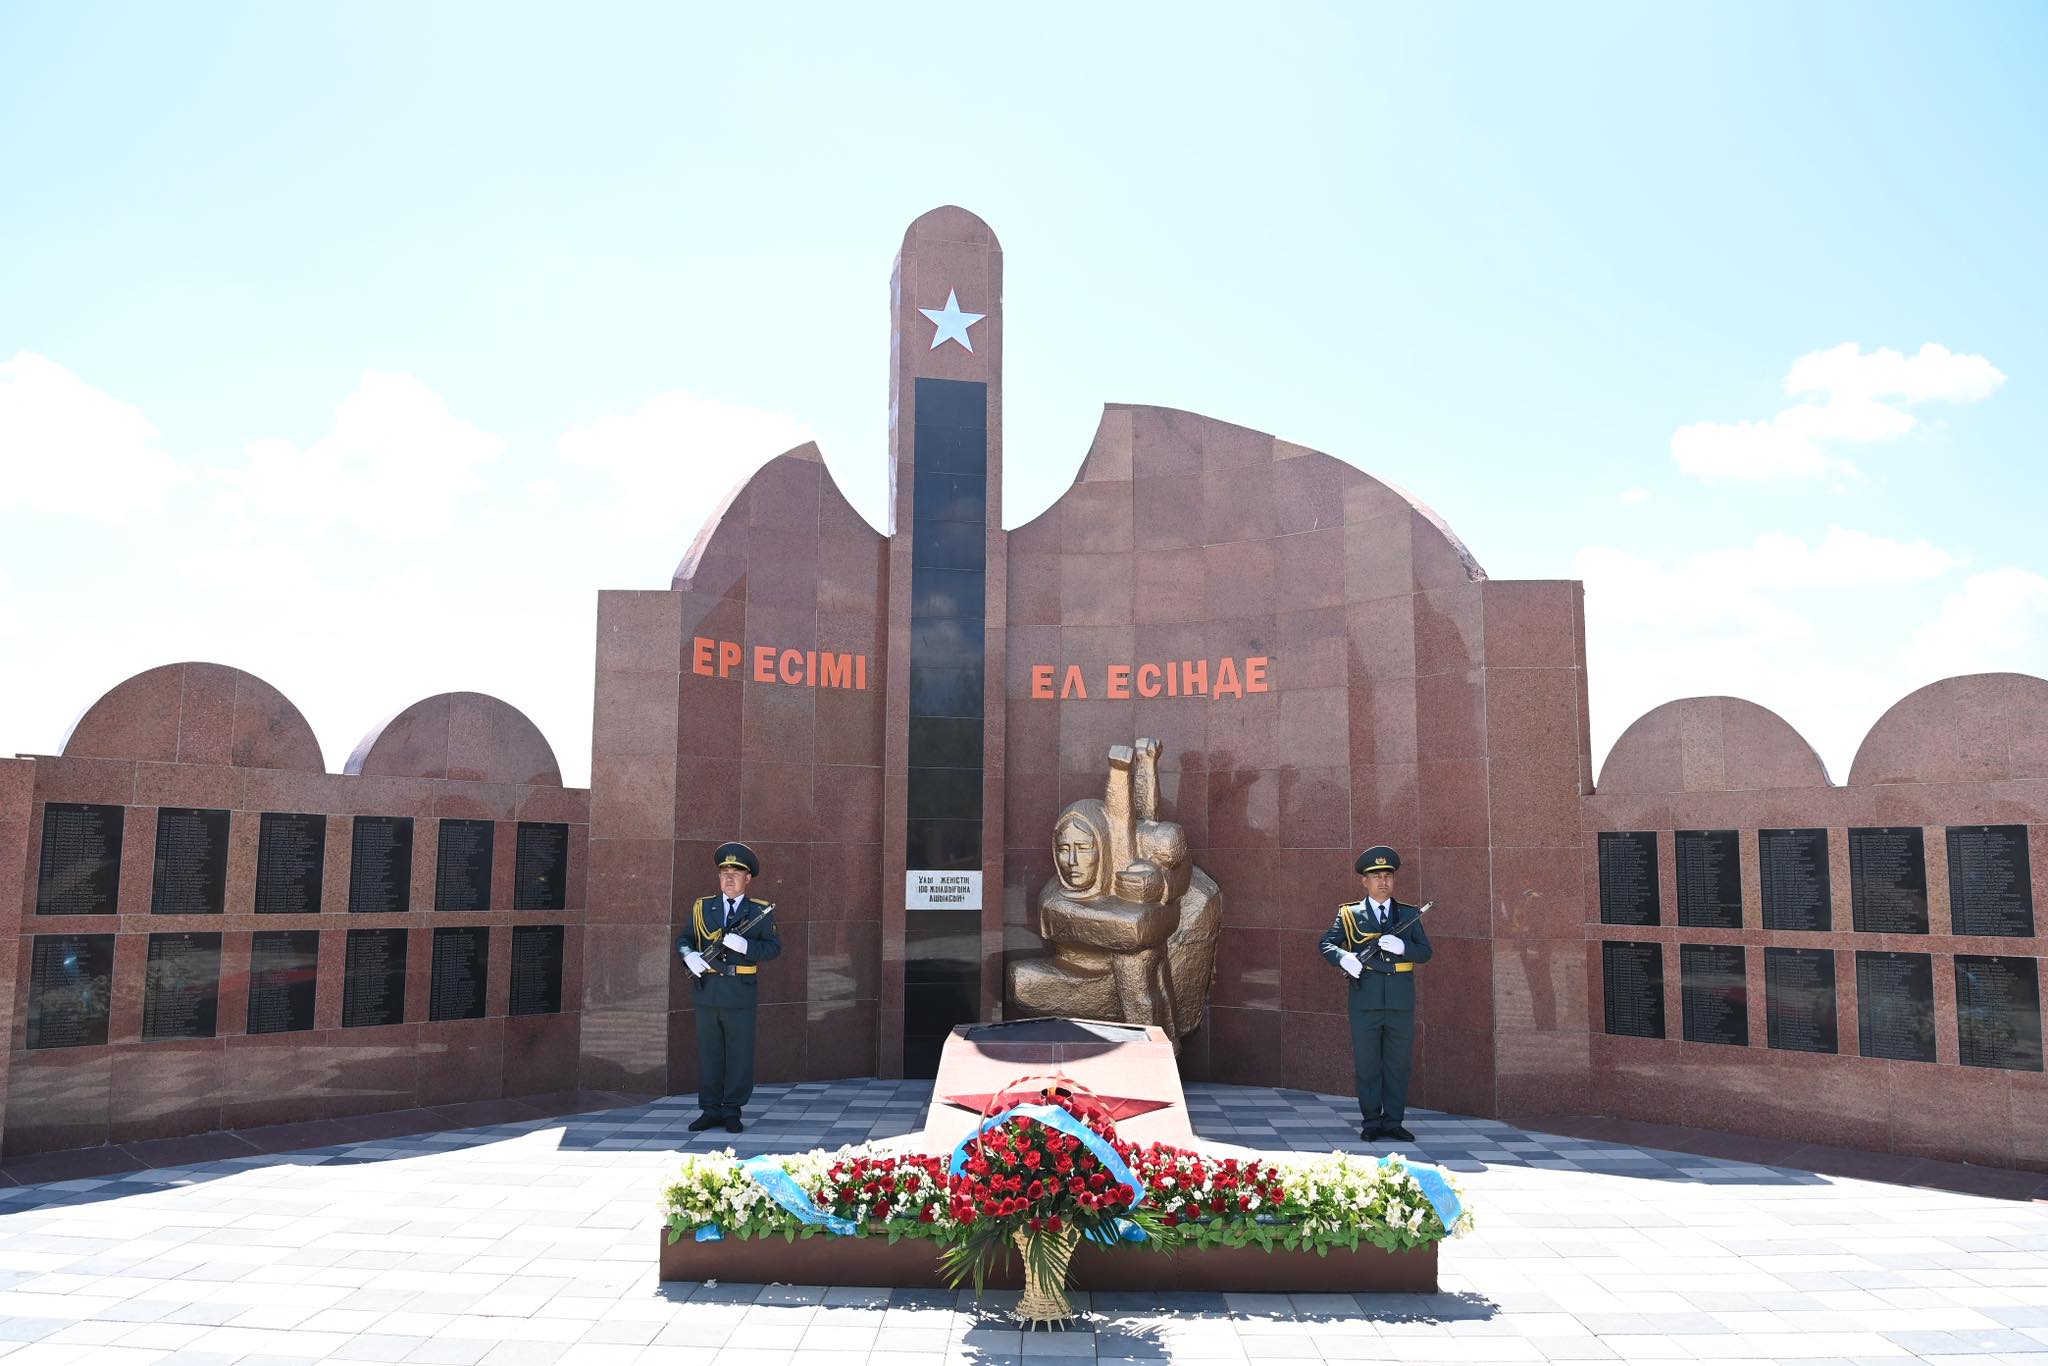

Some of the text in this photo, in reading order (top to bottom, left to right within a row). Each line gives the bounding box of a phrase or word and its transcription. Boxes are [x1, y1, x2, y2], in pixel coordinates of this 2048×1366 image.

[693, 636, 866, 689] ЕР ЕСІМІ
[1032, 656, 1268, 700] ЕЛ ЕСІНДЕ
